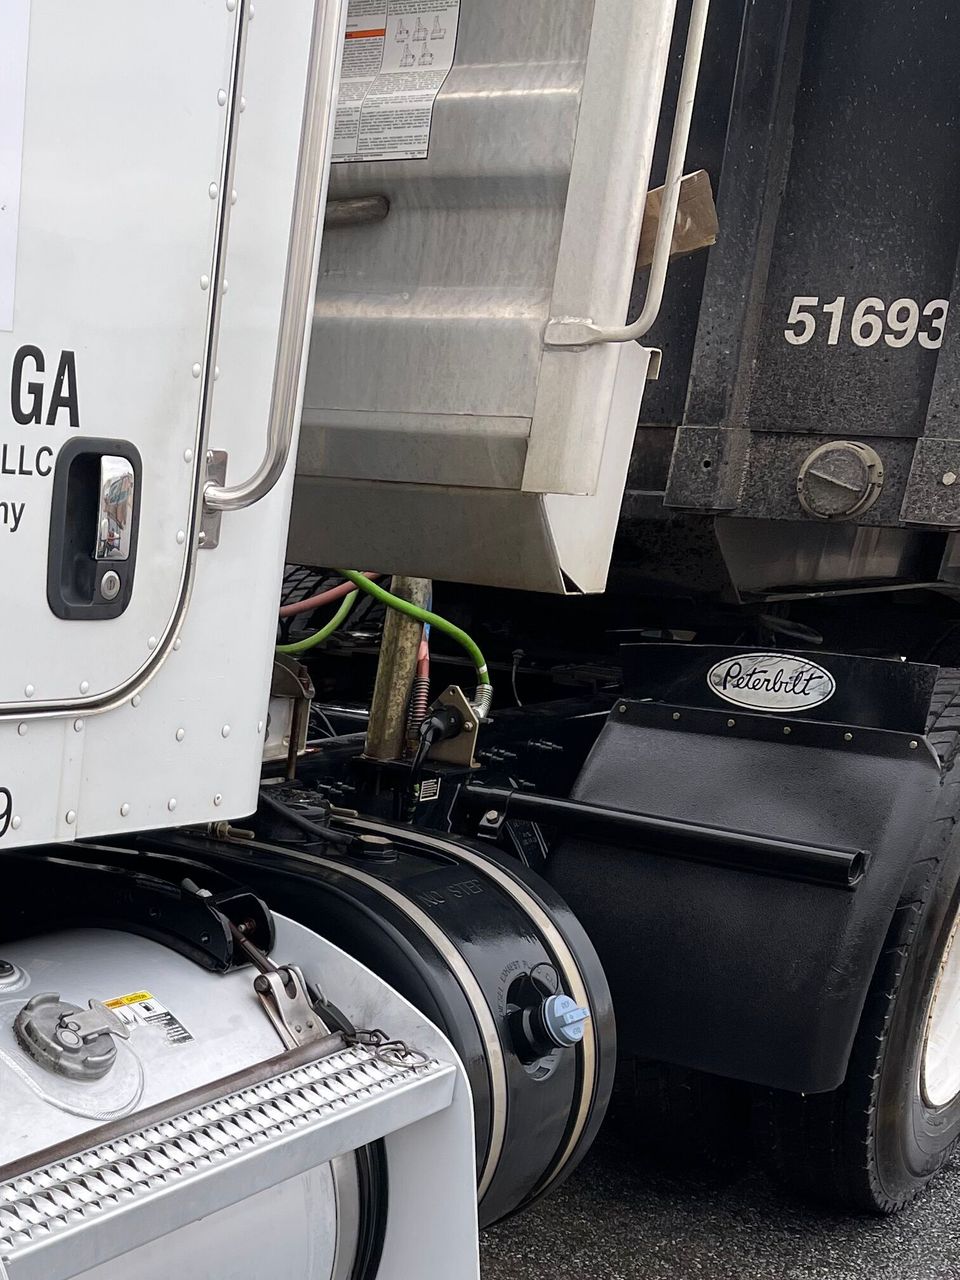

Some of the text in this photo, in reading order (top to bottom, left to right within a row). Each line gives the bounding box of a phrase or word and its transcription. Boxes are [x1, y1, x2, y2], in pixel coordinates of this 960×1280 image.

[784, 296, 949, 349] 51693
[10, 345, 80, 428] GA
[1, 443, 54, 477] LLC
[722, 662, 824, 695] Peterbilt
